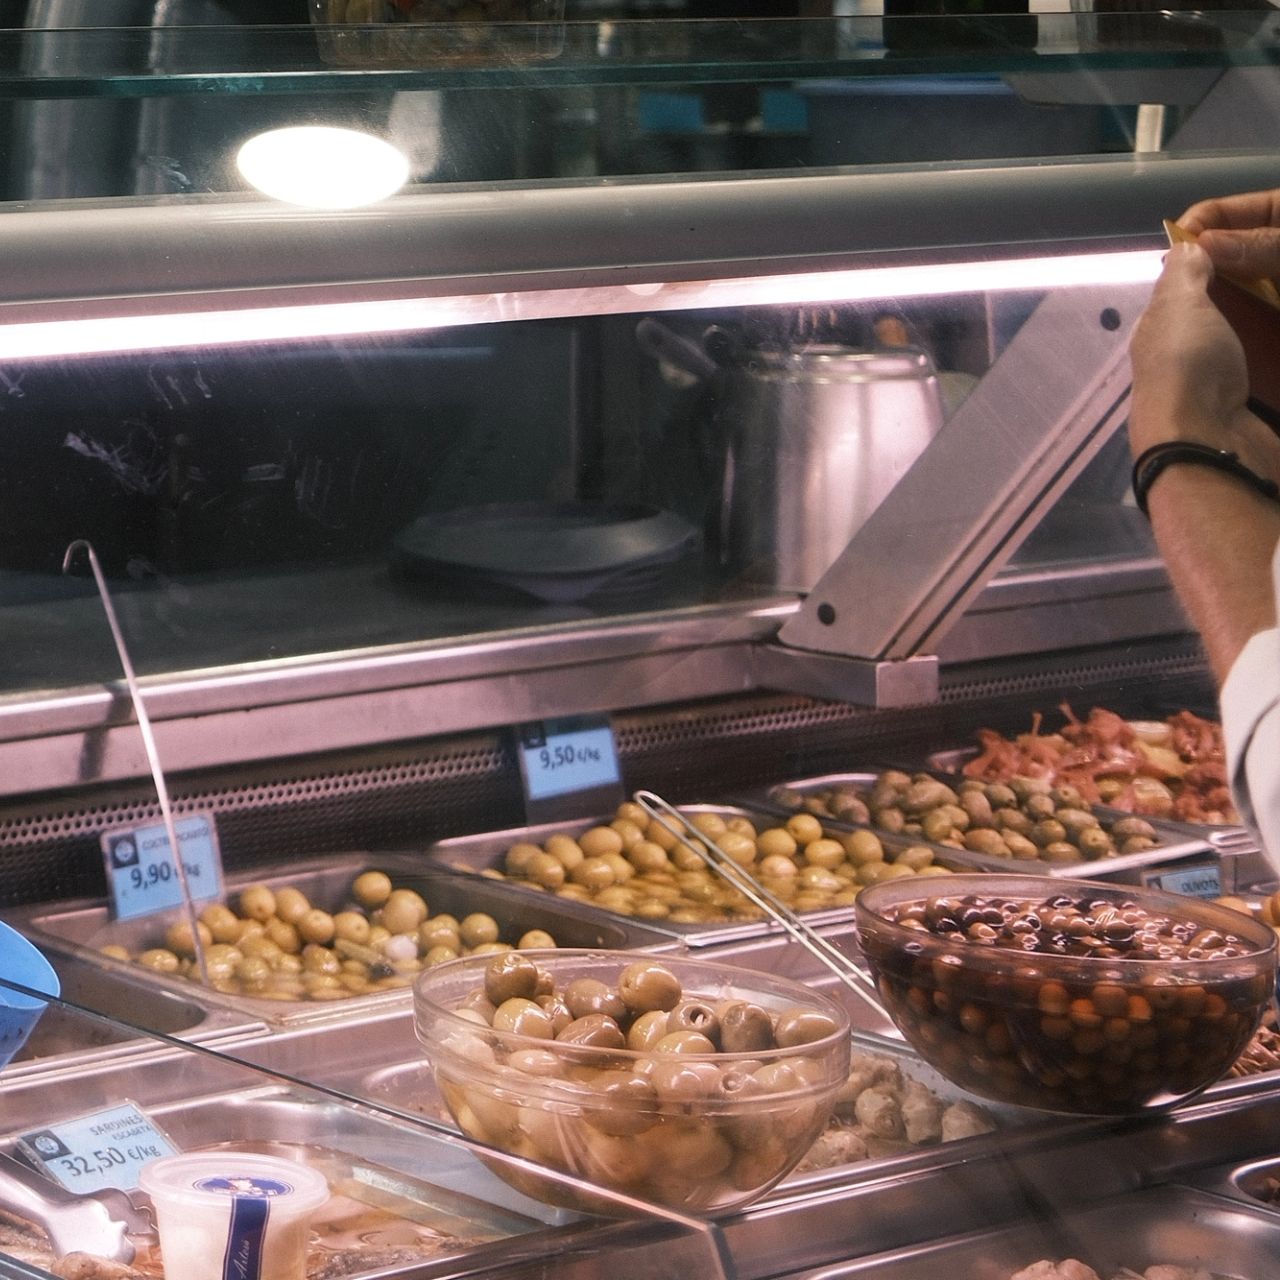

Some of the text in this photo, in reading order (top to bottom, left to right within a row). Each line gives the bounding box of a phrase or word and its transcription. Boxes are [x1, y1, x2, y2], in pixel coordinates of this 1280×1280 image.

[540, 745, 575, 770] 9,50
[130, 861, 171, 890] 9,90
[90, 1115, 143, 1136] SARDINES
[61, 1144, 162, 1177] 32,50 €/kg
